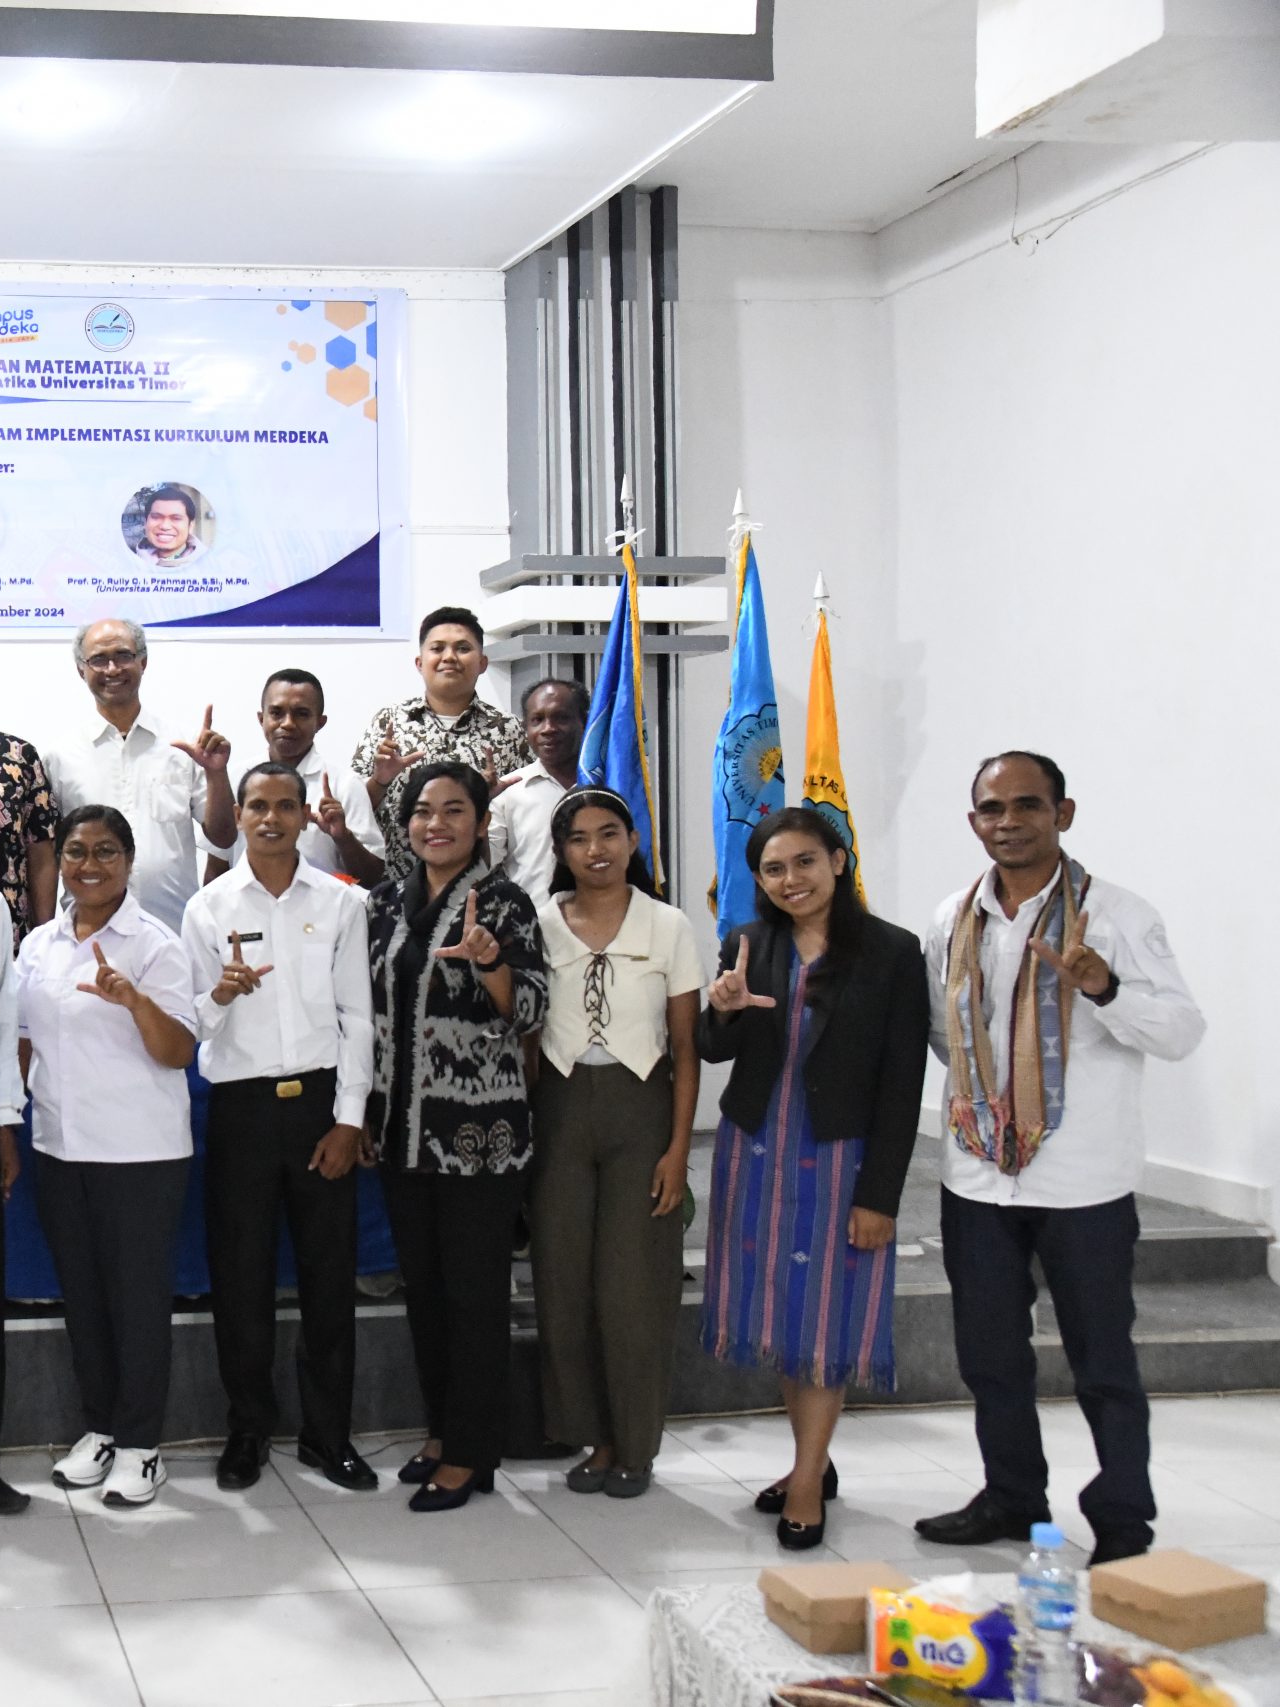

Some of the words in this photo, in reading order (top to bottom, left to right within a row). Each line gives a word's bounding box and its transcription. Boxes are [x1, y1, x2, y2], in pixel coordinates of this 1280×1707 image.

[25, 359, 146, 375] MATEMATIKA
[153, 361, 170, 376] II
[40, 376, 135, 390] Universitas
[139, 377, 186, 390] Timor
[25, 428, 151, 442] IMPLEMENTASI
[154, 429, 250, 443] KURIKULUM
[253, 430, 329, 444] MERDEKA
[9, 578, 34, 586] M.Pd.
[67, 577, 89, 586] Prof.
[91, 577, 105, 586] Dr.
[107, 577, 130, 587] Rully
[150, 577, 200, 587] Prahmana,
[225, 577, 250, 586] M.Pd.
[96, 585, 151, 593] (Universitas
[152, 585, 185, 593] Ahmad
[187, 585, 223, 594] Dahlan)
[34, 607, 65, 618] 2024
[731, 727, 756, 807] UNIVERSITAS
[755, 717, 779, 730] TIM
